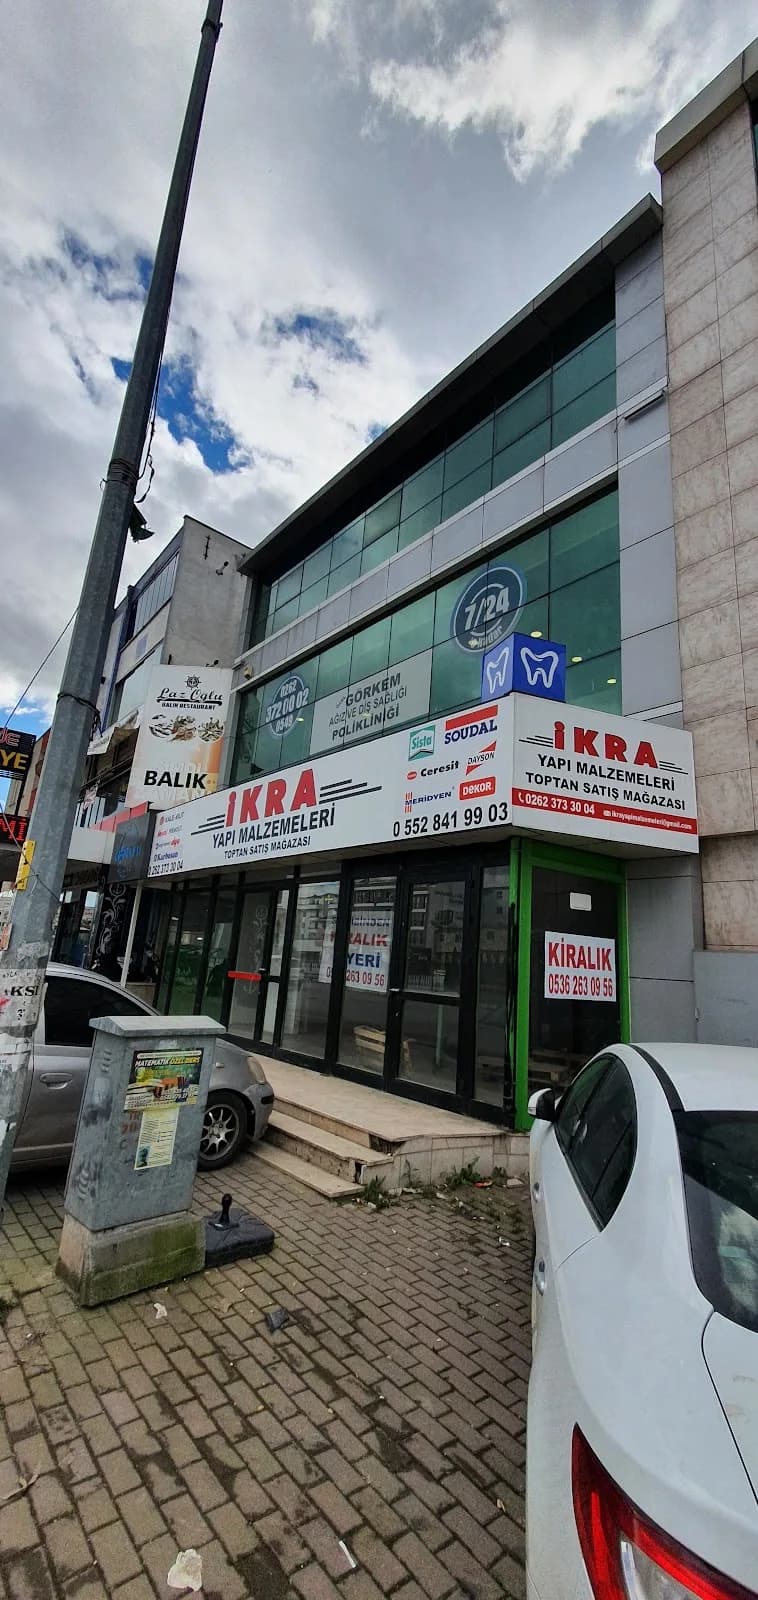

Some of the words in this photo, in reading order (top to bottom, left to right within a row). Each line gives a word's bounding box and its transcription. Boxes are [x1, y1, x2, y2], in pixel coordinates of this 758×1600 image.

[464, 586, 509, 631] 7/24
[411, 735, 433, 750] Sista
[445, 719, 498, 745] SOUDAL
[421, 760, 459, 777] Ceresit
[467, 752, 495, 765] DAYSON
[143, 770, 208, 790] BALIK
[538, 754, 571, 772] YAPI
[576, 761, 675, 791] MALZEMELERİ
[525, 772, 579, 791] TOPTAN
[583, 782, 619, 801] SATIŞ
[623, 790, 685, 811] MAĞAZASI
[525, 794, 549, 807] 0262
[550, 799, 568, 810] 373
[570, 803, 581, 812] 30
[583, 806, 595, 816] 04
[212, 830, 235, 849] YAPI
[238, 802, 335, 844] MALZEMELERİ
[393, 822, 400, 837] 0
[404, 816, 428, 836] 552
[432, 810, 458, 831] 841
[464, 806, 483, 826] 99
[488, 802, 509, 823] 03
[224, 847, 248, 860] TOPTAN
[346, 952, 381, 968] YERİ
[548, 937, 612, 971] KİRALIK
[548, 973, 570, 995] 0536
[572, 975, 588, 996] 263
[590, 976, 601, 997] 09
[603, 977, 614, 998] 56
